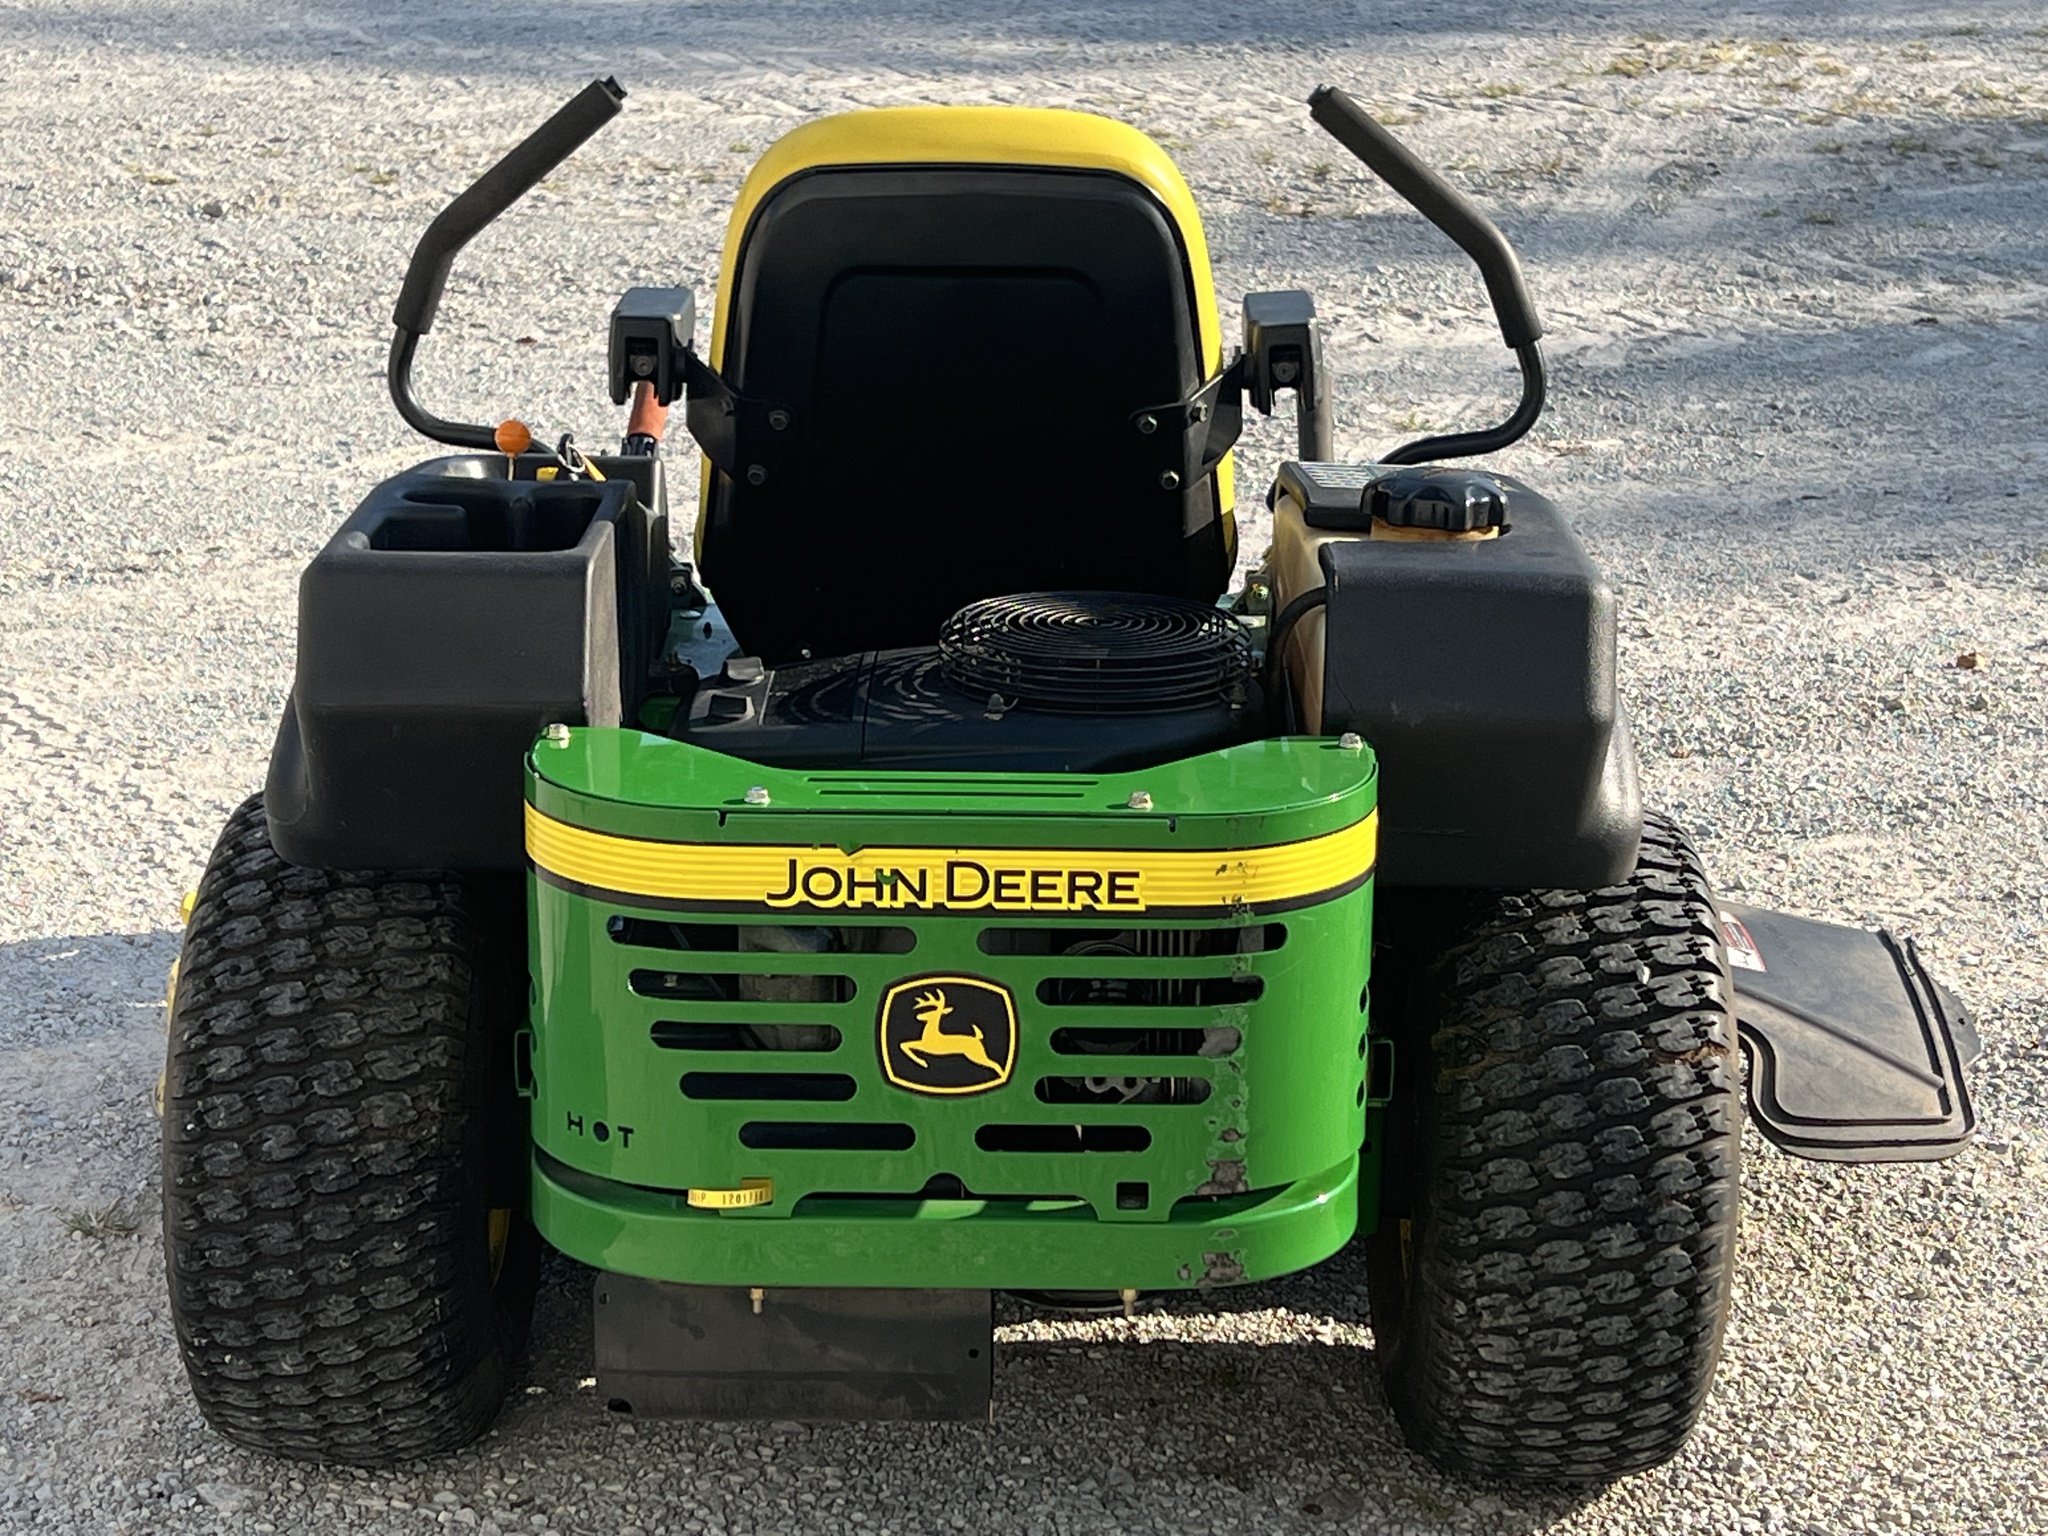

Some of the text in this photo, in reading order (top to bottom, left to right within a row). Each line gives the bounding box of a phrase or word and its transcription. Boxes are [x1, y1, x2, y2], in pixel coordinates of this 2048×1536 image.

[766, 858, 1143, 908] JOHN DEERE
[566, 1110, 635, 1149] HOT
